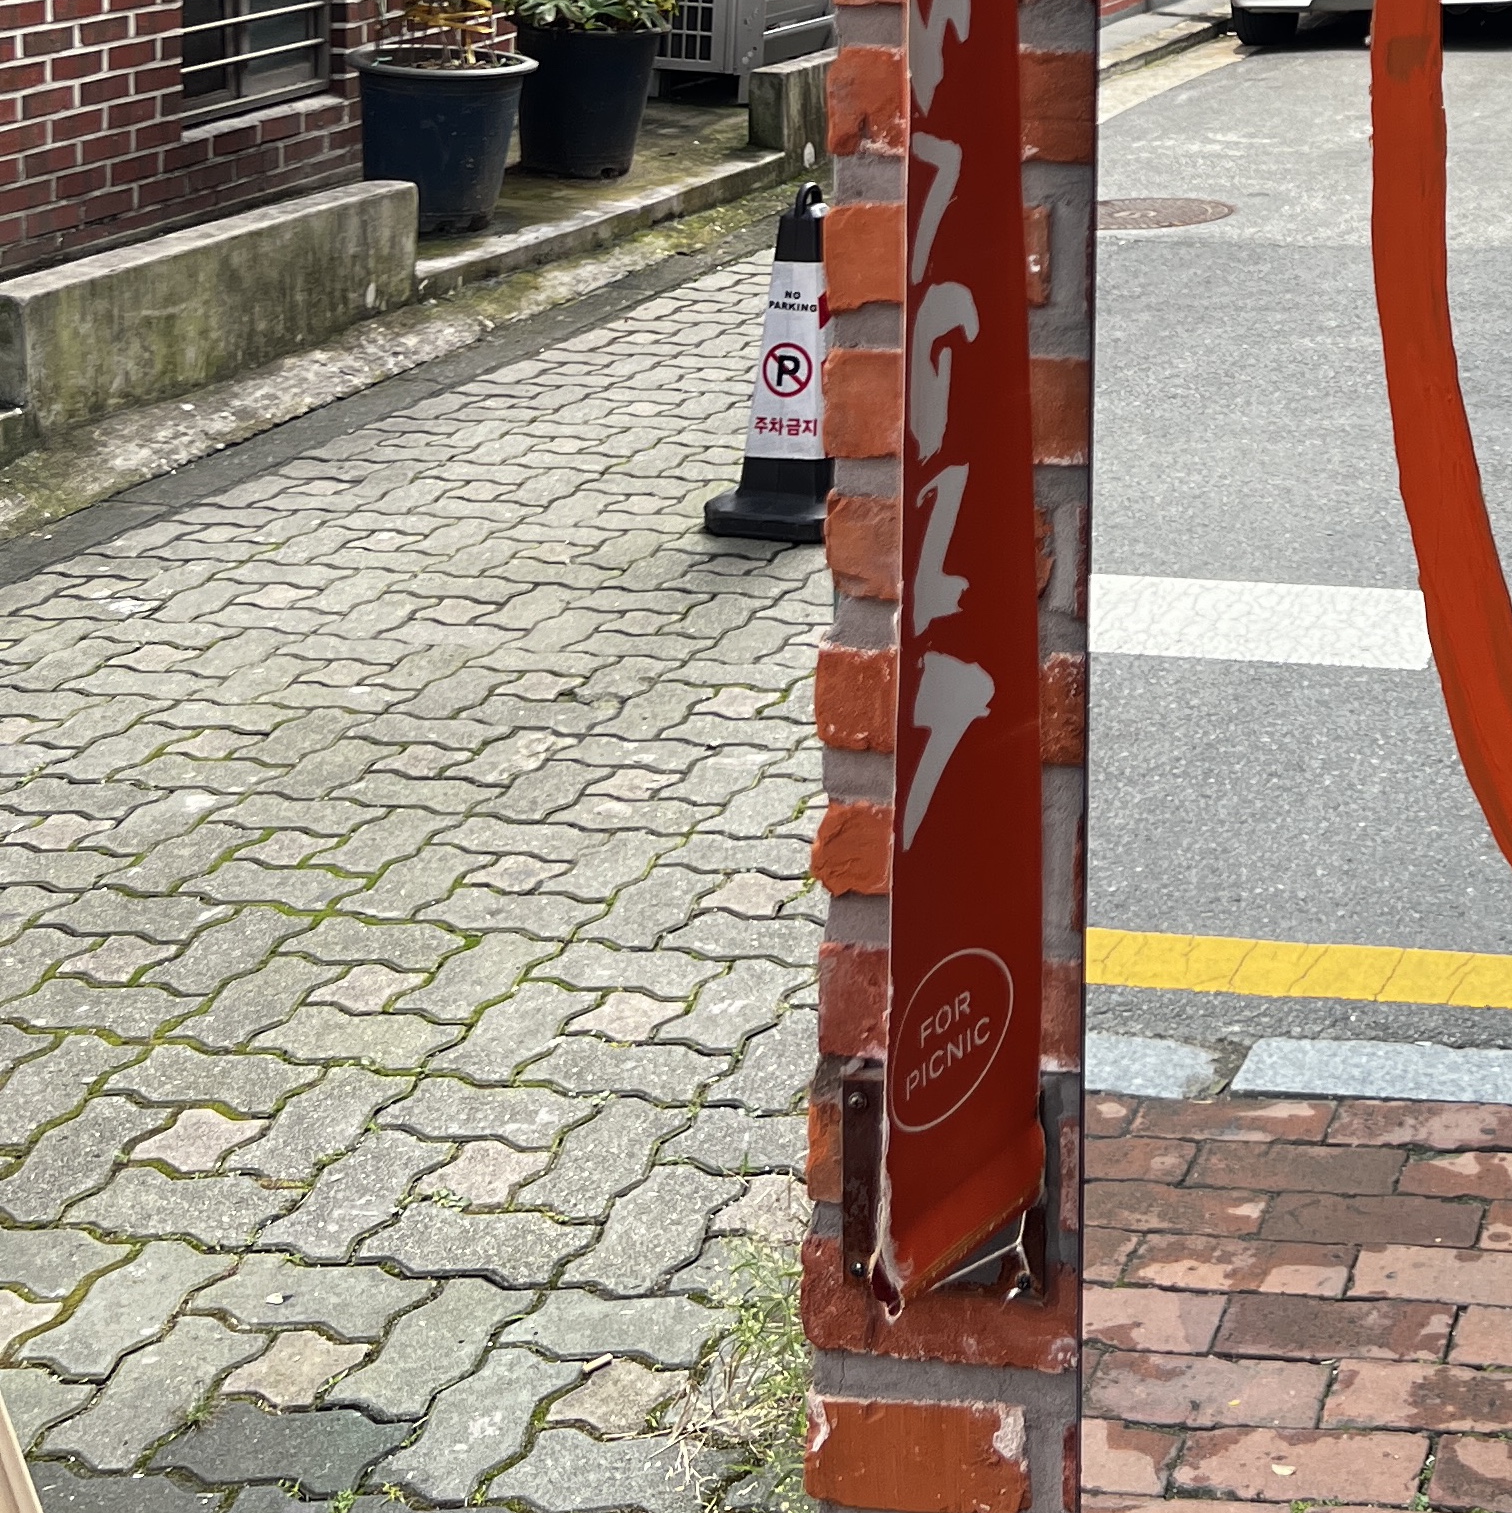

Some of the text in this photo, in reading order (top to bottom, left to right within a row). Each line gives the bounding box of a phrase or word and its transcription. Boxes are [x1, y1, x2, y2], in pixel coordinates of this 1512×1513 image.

[784, 290, 801, 300] NO
[768, 300, 818, 313] PARKING
[754, 416, 818, 437] 주차금지
[920, 990, 970, 1049] FOR
[905, 1016, 990, 1101] PICNIC
